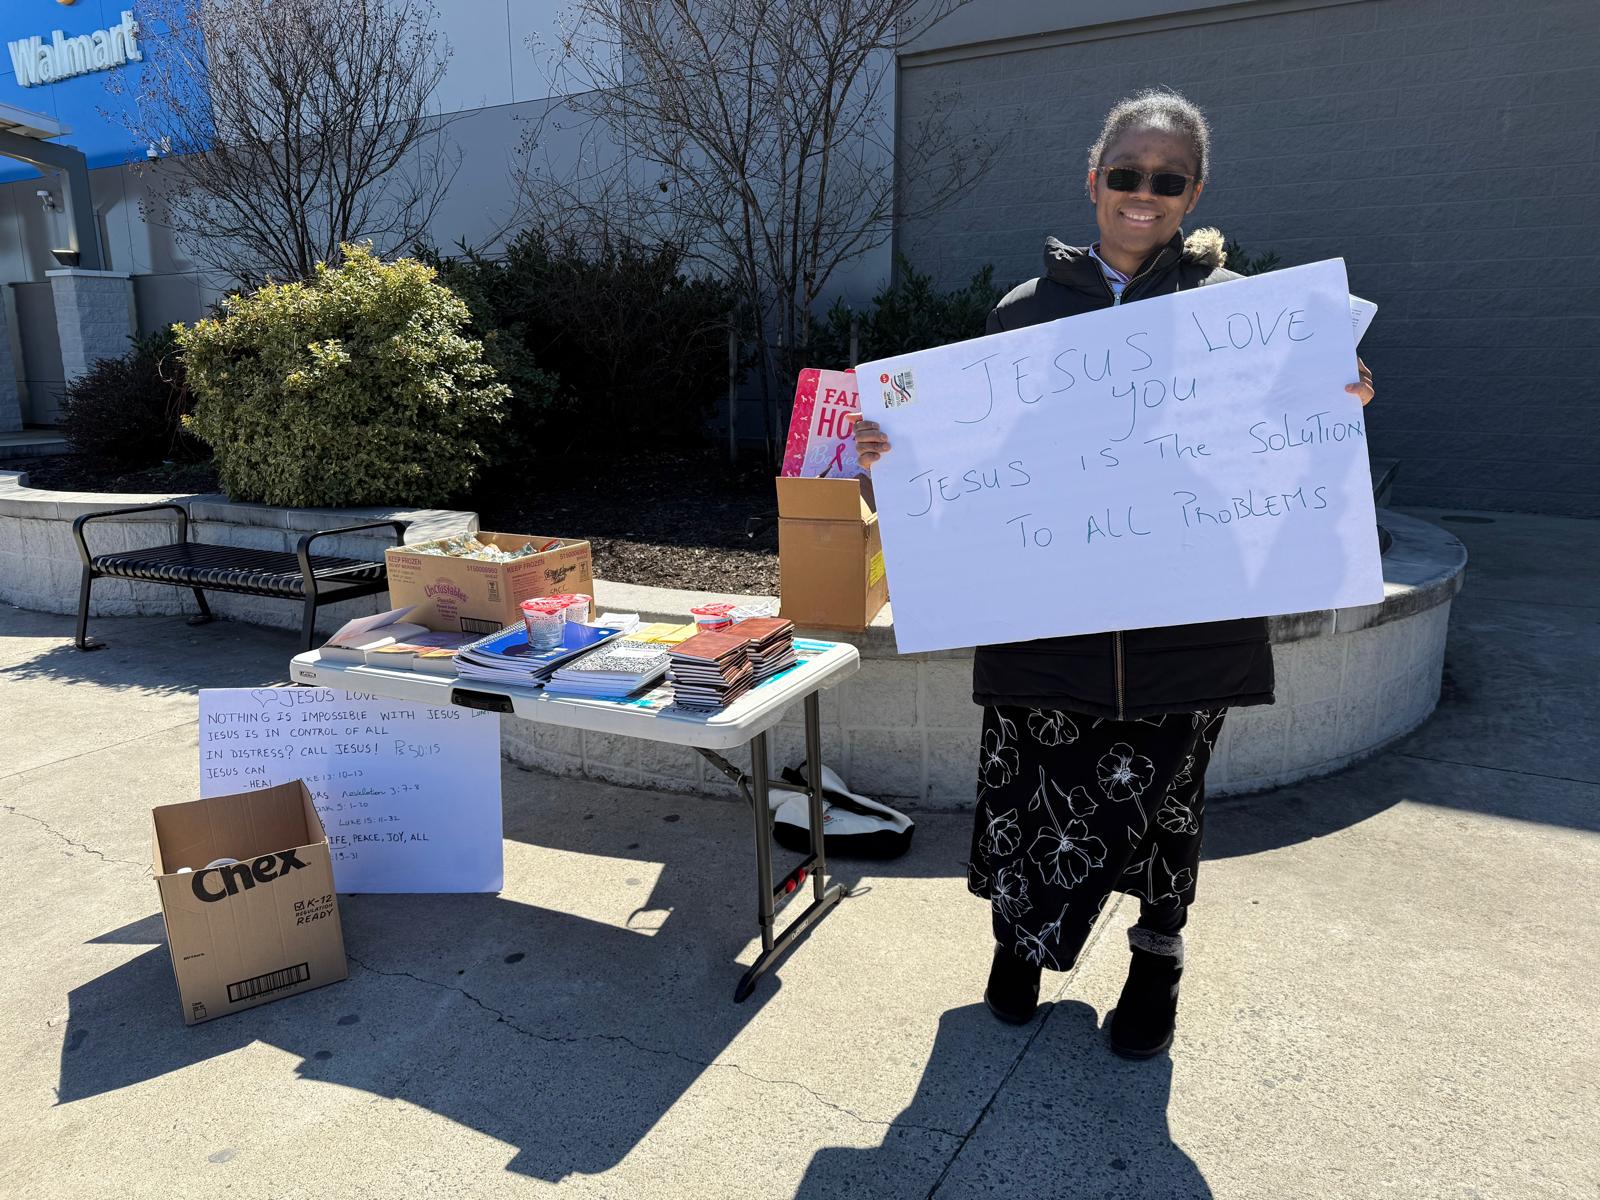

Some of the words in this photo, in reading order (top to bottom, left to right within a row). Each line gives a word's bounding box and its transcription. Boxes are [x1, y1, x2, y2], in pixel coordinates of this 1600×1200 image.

[8, 10, 143, 88] Walmart
[955, 332, 1153, 424] JESUS
[1192, 307, 1314, 353] LOVE
[906, 460, 1032, 517] JESUS
[1087, 505, 1151, 544] ALL
[424, 582, 468, 602] Uncrustables
[280, 689, 335, 707] JESUS
[208, 712, 271, 724] NOTHING
[277, 712, 292, 721] IS
[301, 710, 368, 722] IMPOSSIBLE
[380, 711, 415, 721] WITH
[427, 709, 460, 720] JESUS
[207, 731, 240, 741] JESUS
[245, 729, 259, 738] IS
[265, 728, 280, 738] IN
[289, 728, 338, 738] CONTROL
[345, 727, 360, 735] OF
[365, 726, 389, 735] ALL
[206, 749, 223, 760] IN
[231, 744, 294, 760] DISTRESS?
[335, 742, 379, 755] JESUS!
[206, 767, 239, 779] JESUS
[244, 765, 266, 775] CAN
[352, 833, 385, 844] PEACE,
[409, 833, 431, 841] ALL
[306, 894, 333, 909] K-12
[296, 908, 334, 926] READY
